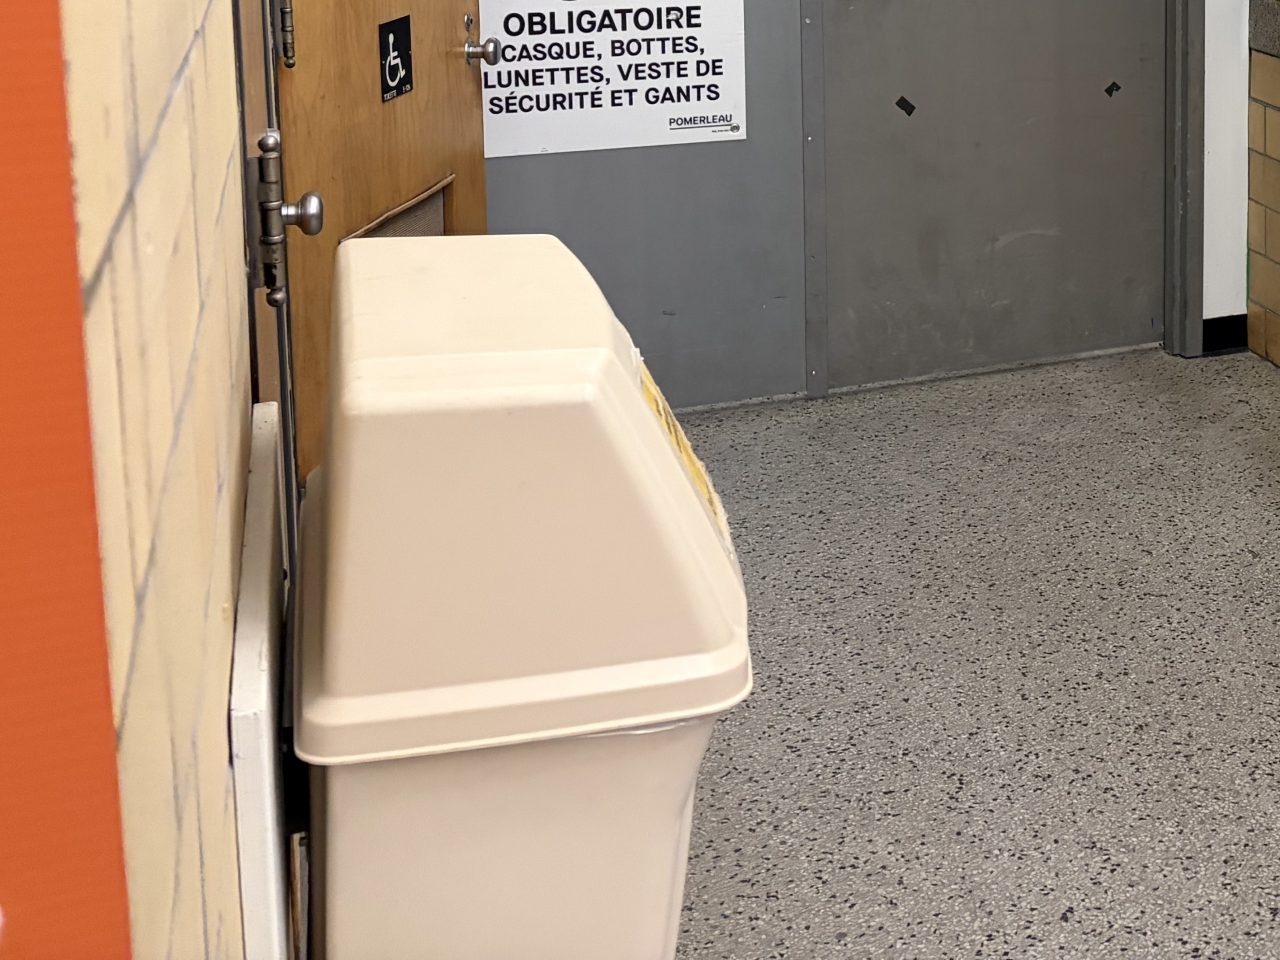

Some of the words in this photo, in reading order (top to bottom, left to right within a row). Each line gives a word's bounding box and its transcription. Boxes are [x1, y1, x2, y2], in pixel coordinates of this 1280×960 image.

[502, 5, 702, 37] OBLIGATOIRE
[501, 41, 602, 63] CASQUE,
[610, 36, 705, 58] BOTTES,
[483, 66, 611, 89] LUNETTES,
[616, 61, 689, 81] VESTE
[695, 59, 724, 76] DE
[488, 86, 603, 115] SÉCURITÉ
[610, 89, 638, 107] ET
[644, 84, 720, 105] GANTS
[669, 114, 733, 127] POMERLEAU
